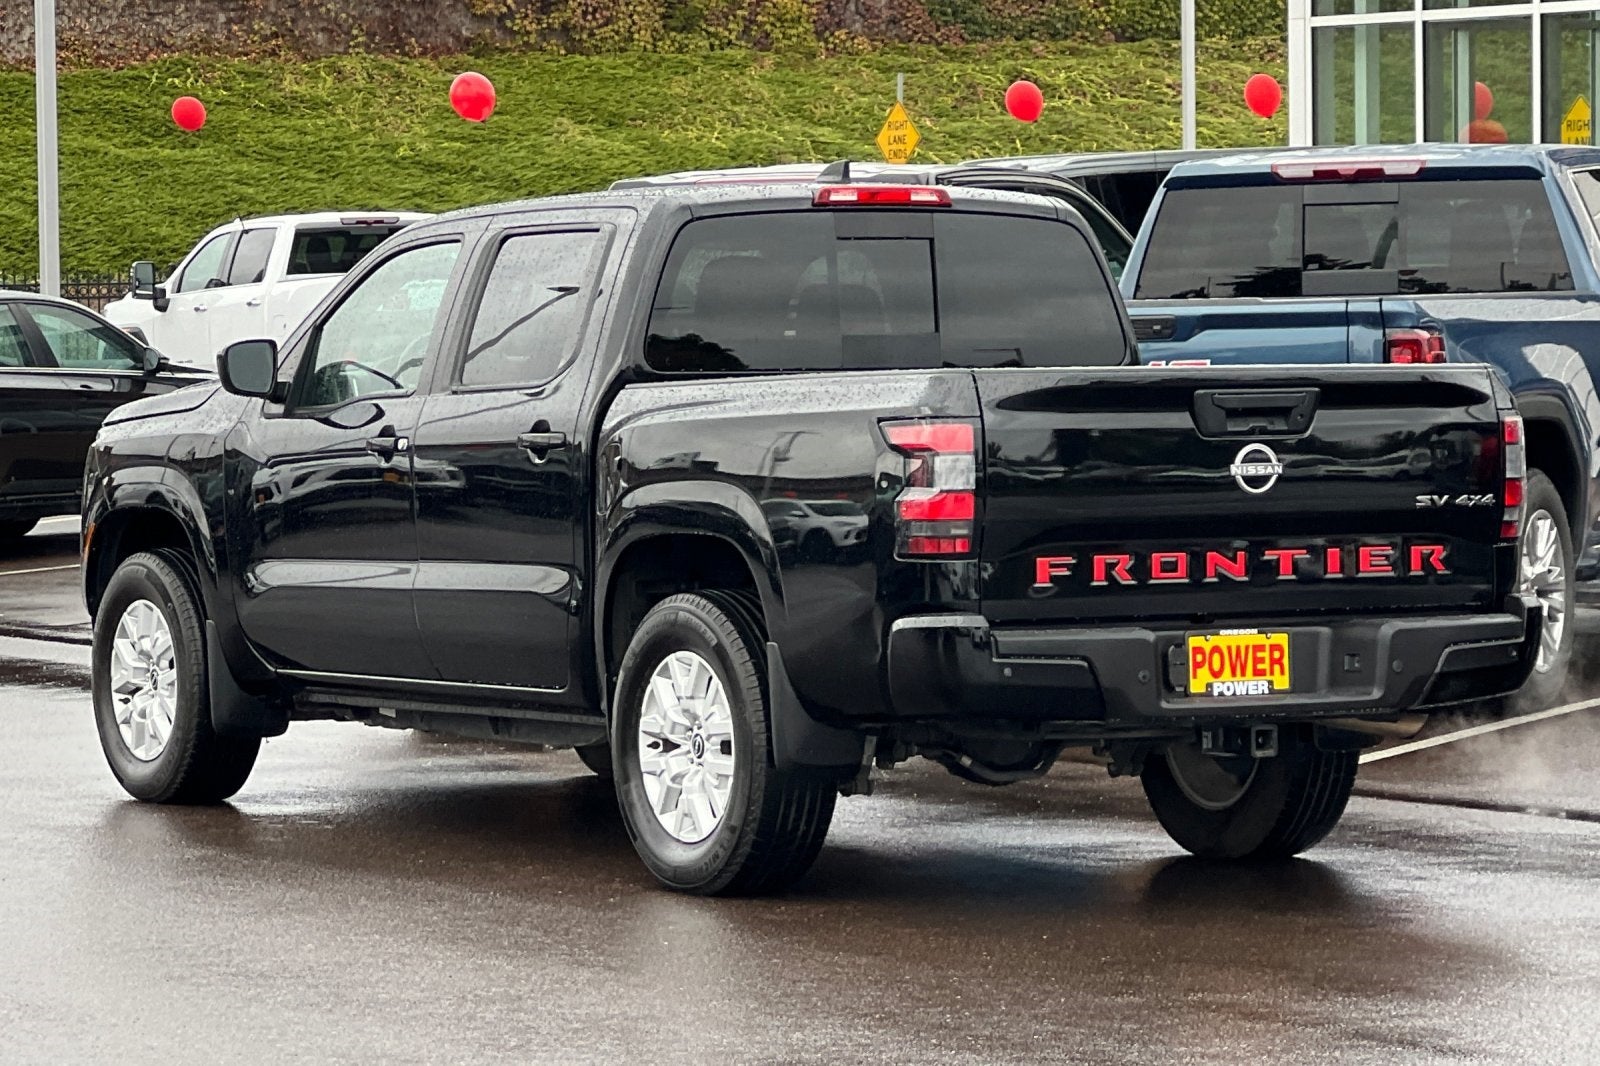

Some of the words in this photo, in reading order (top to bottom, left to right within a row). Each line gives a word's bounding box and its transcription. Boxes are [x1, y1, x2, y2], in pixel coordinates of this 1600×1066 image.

[887, 120, 908, 131] RIGHT
[1566, 119, 1591, 132] RIGH
[887, 134, 908, 146] LANE
[888, 149, 908, 160] ENDS
[1230, 463, 1283, 476] NISSAN
[1415, 494, 1449, 508] SV
[1032, 545, 1451, 588] FRONTIER
[1191, 643, 1286, 680] POWER
[1212, 680, 1270, 697] POWER
